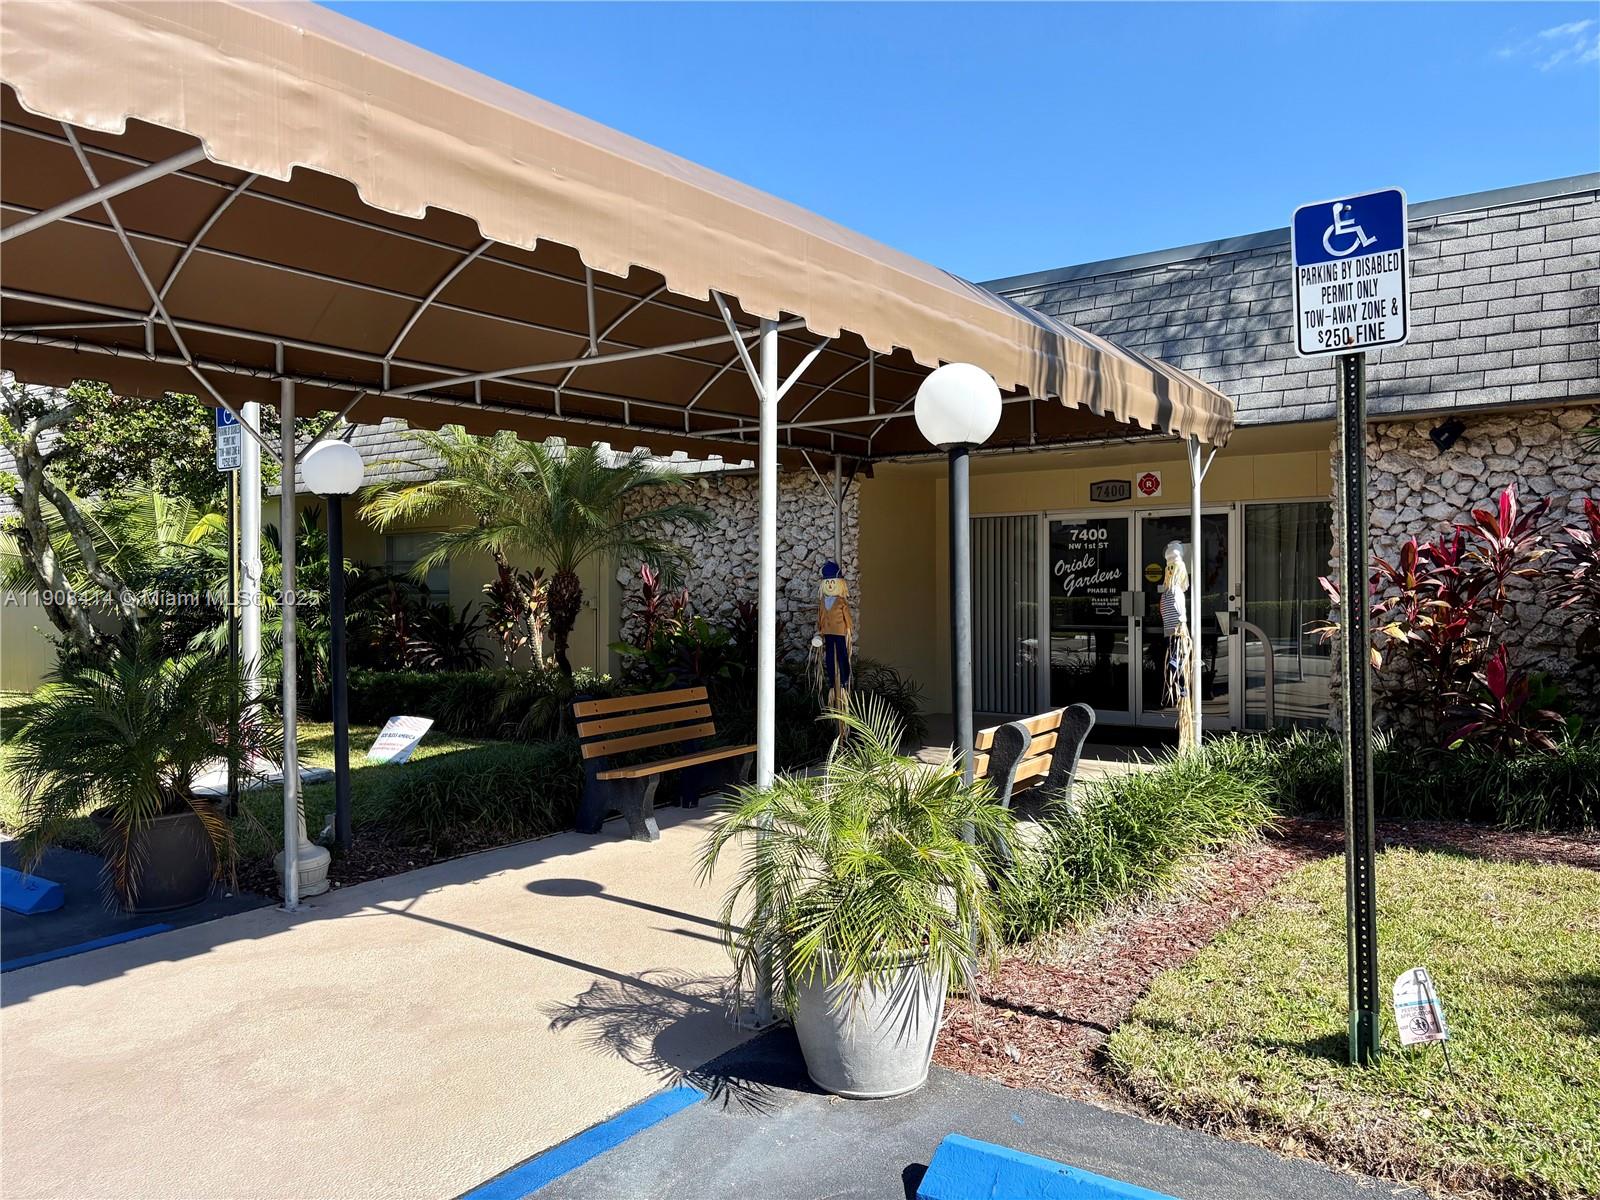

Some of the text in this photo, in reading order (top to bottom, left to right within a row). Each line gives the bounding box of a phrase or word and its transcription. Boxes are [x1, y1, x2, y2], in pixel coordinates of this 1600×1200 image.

[1301, 252, 1399, 286] PARKING BY DISABLED
[1321, 278, 1379, 305] PERMIT ONLY
[1304, 297, 1399, 329] TOW-AWAY ZONE &
[1318, 321, 1386, 348] $250 FINE
[1096, 484, 1125, 498] 7400
[1070, 528, 1108, 541] 7400
[1054, 553, 1096, 576] Oriole
[1063, 568, 1122, 597] Gardens
